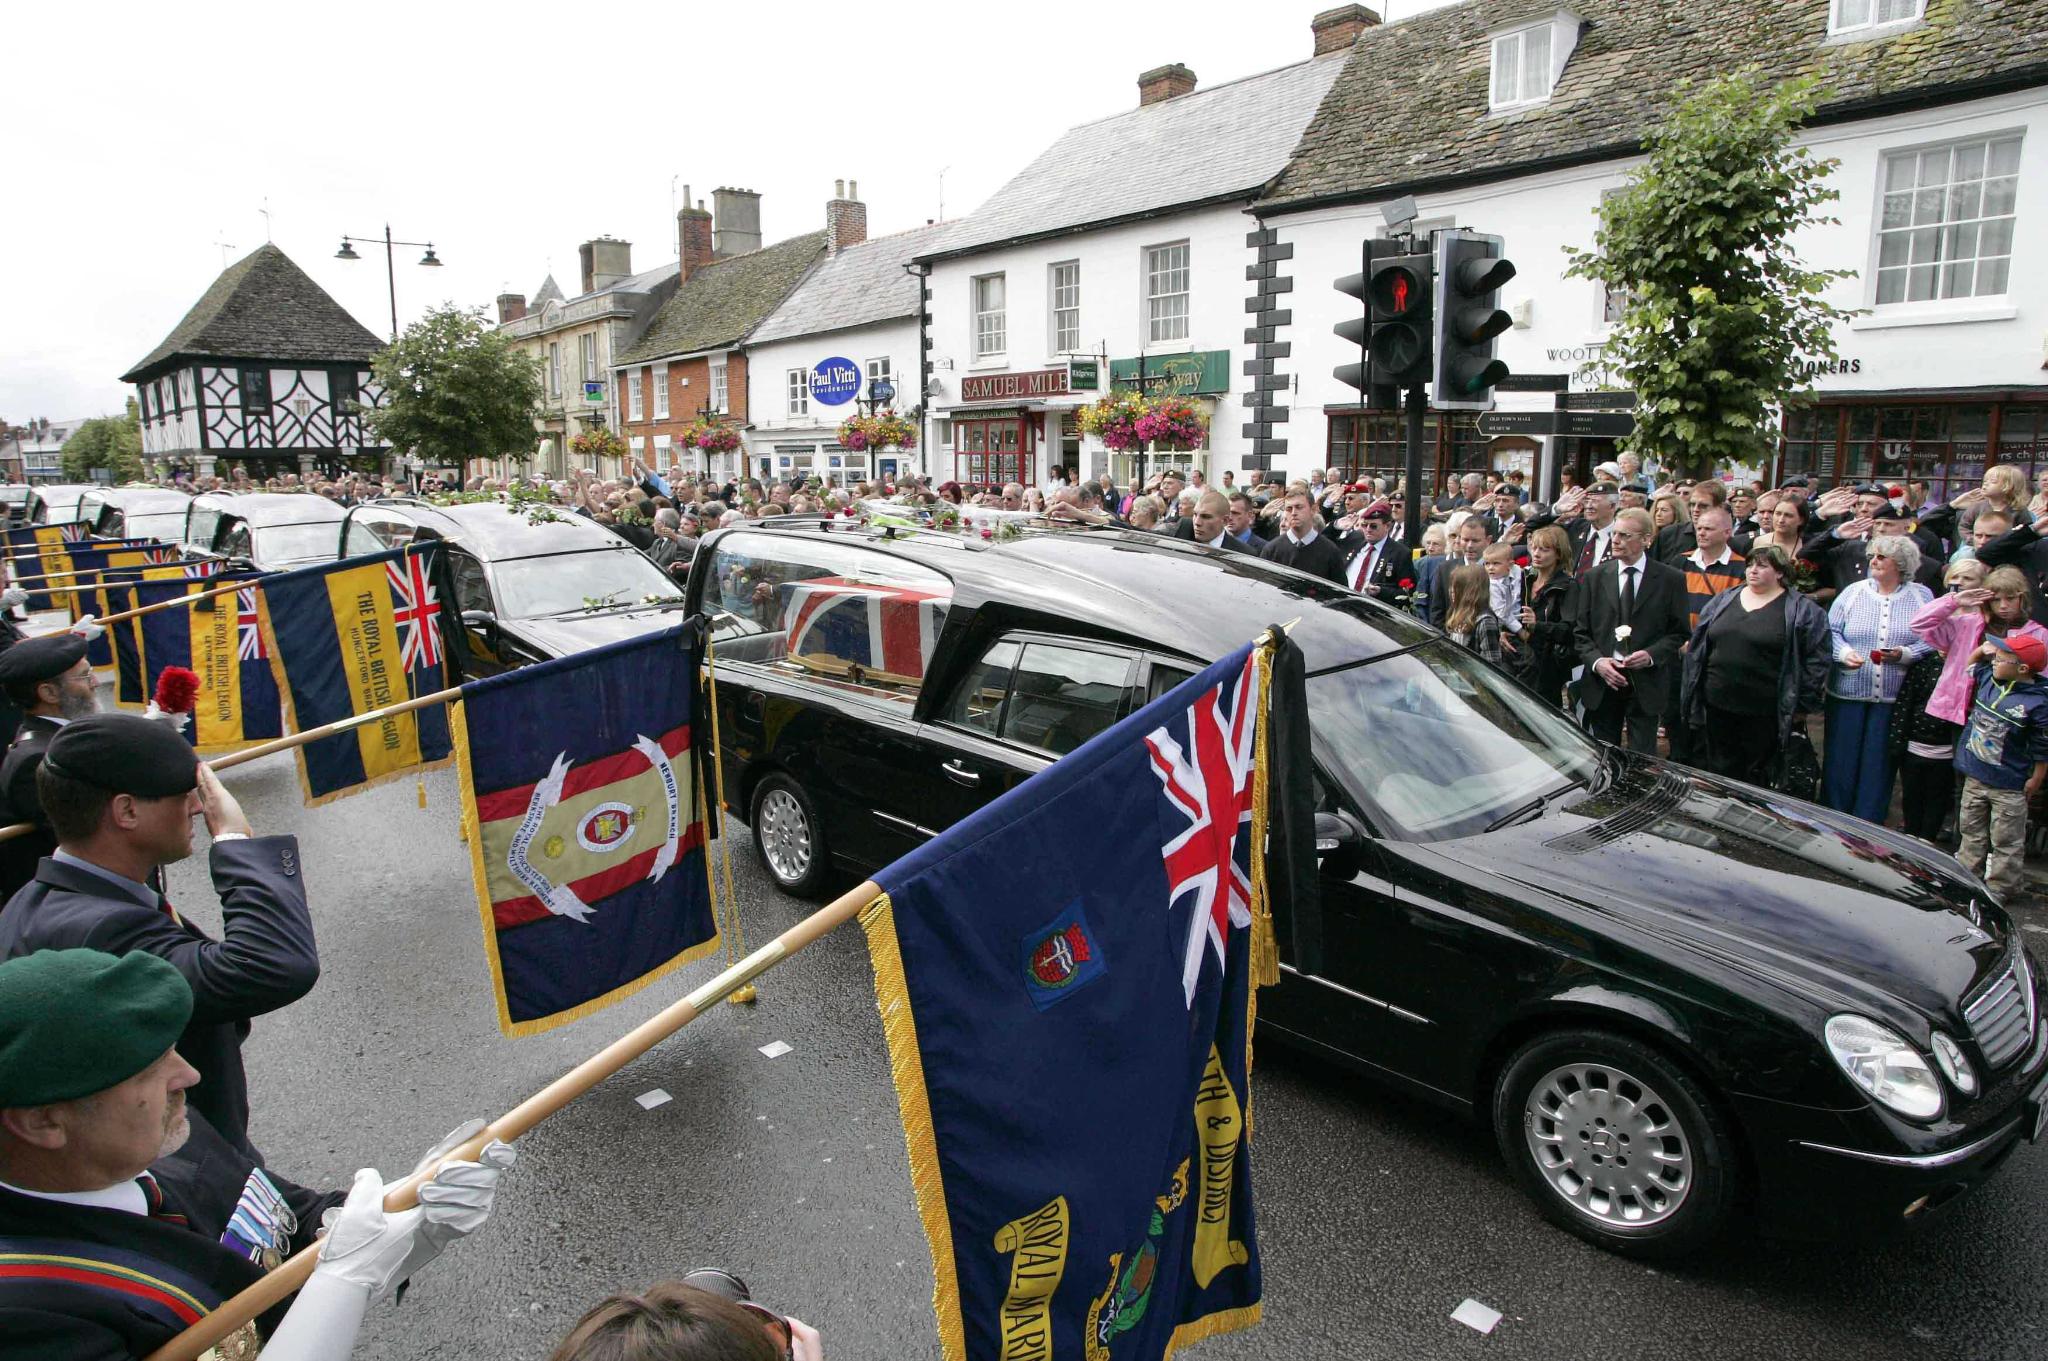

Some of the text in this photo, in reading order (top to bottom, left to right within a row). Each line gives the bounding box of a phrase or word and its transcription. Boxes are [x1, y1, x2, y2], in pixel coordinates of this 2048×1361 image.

[811, 366, 855, 387] Paul Vitti
[811, 382, 856, 394] Residential
[963, 372, 1067, 398] SAMUEL MILE
[214, 604, 232, 722] THE ROYAL BRITISH LEGION
[351, 628, 369, 684] HUNGERFORD
[357, 591, 401, 750] THE ROYAL BRITISH EGION
[206, 666, 214, 690] BRANCH
[519, 792, 541, 832] BERKSHIRE
[535, 805, 545, 820] THE
[659, 762, 677, 839] NEWBURY BRANCH
[511, 833, 521, 848] AND
[520, 822, 539, 845] ROYAL
[509, 849, 529, 881] WILTSHIRE
[1207, 1115, 1232, 1132] &
[1201, 1139, 1239, 1224] DISTRICT
[1016, 1202, 1064, 1289] ROYAL
